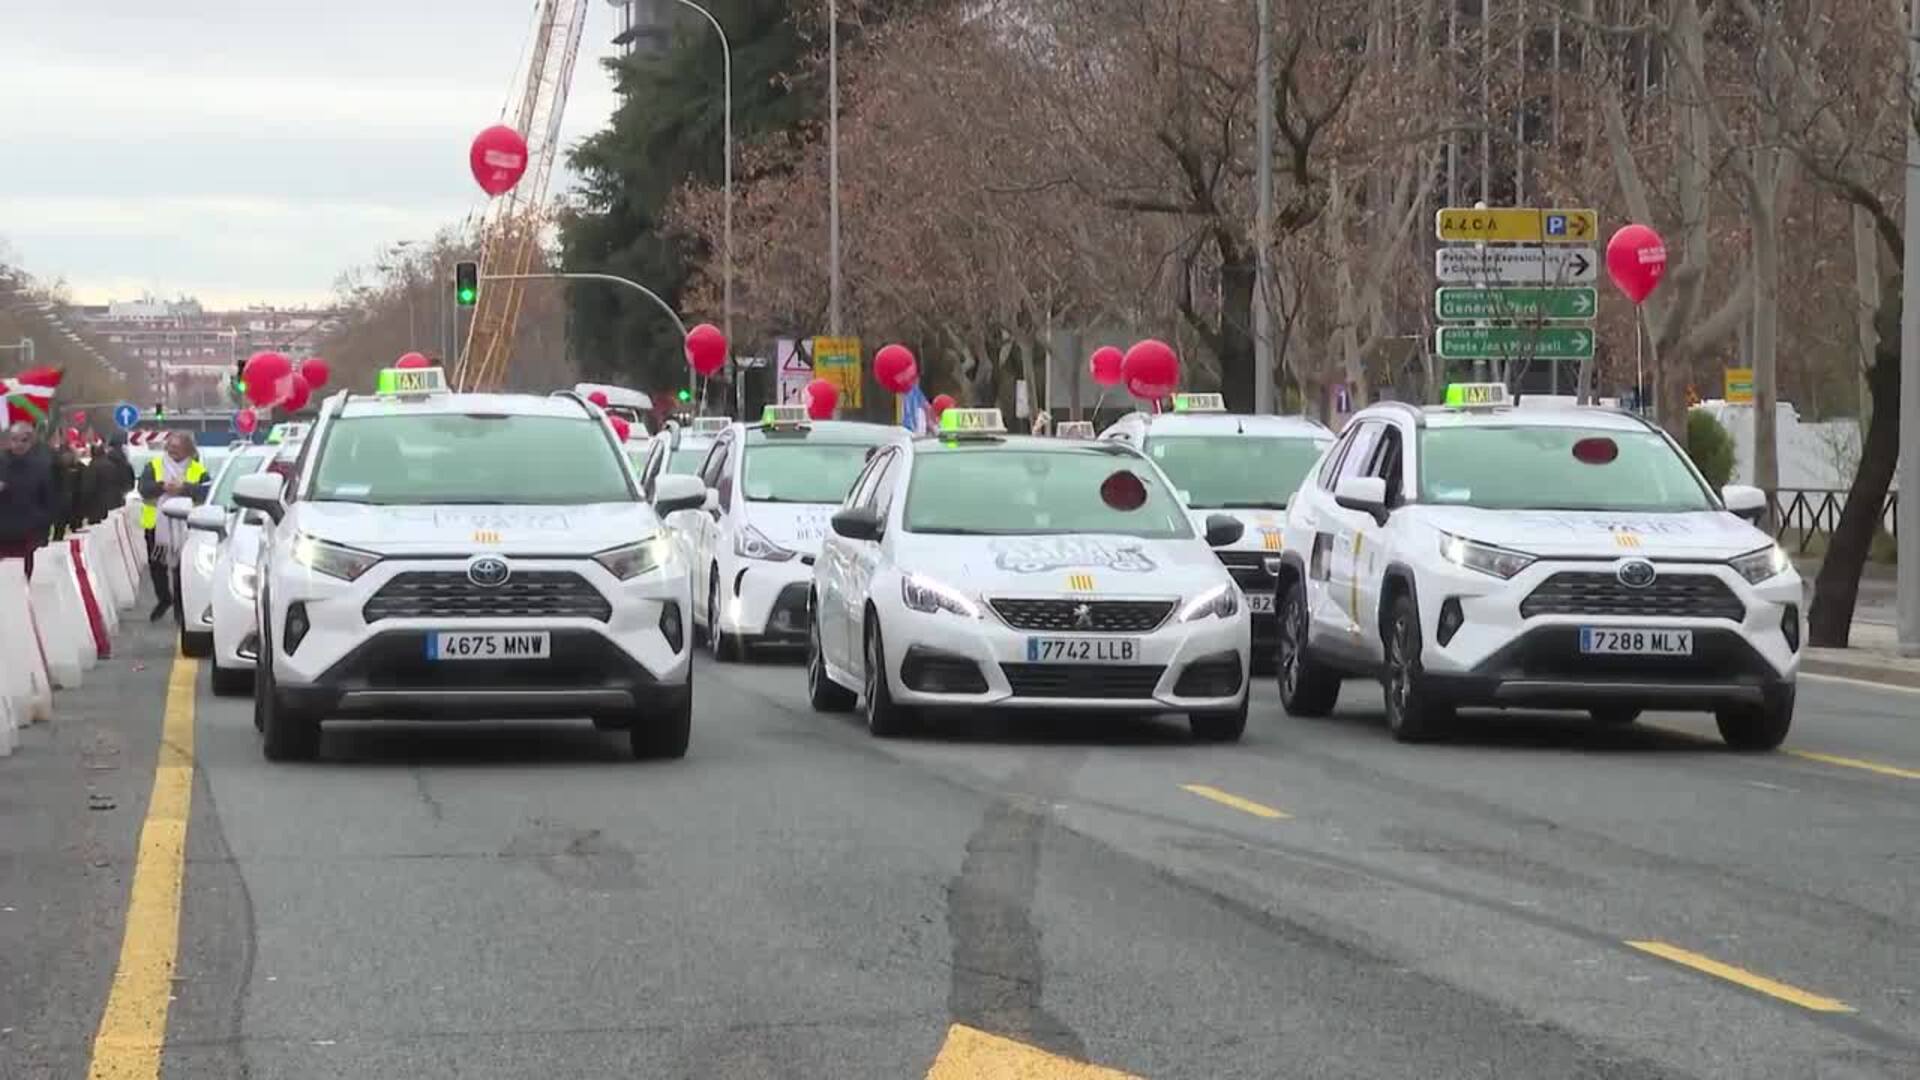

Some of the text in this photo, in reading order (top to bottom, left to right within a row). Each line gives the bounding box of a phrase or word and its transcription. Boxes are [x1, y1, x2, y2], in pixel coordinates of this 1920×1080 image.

[446, 636, 542, 655] 4675 MNW
[1042, 641, 1133, 660] 7742 LLB
[1595, 632, 1689, 652] 7288 MLX
